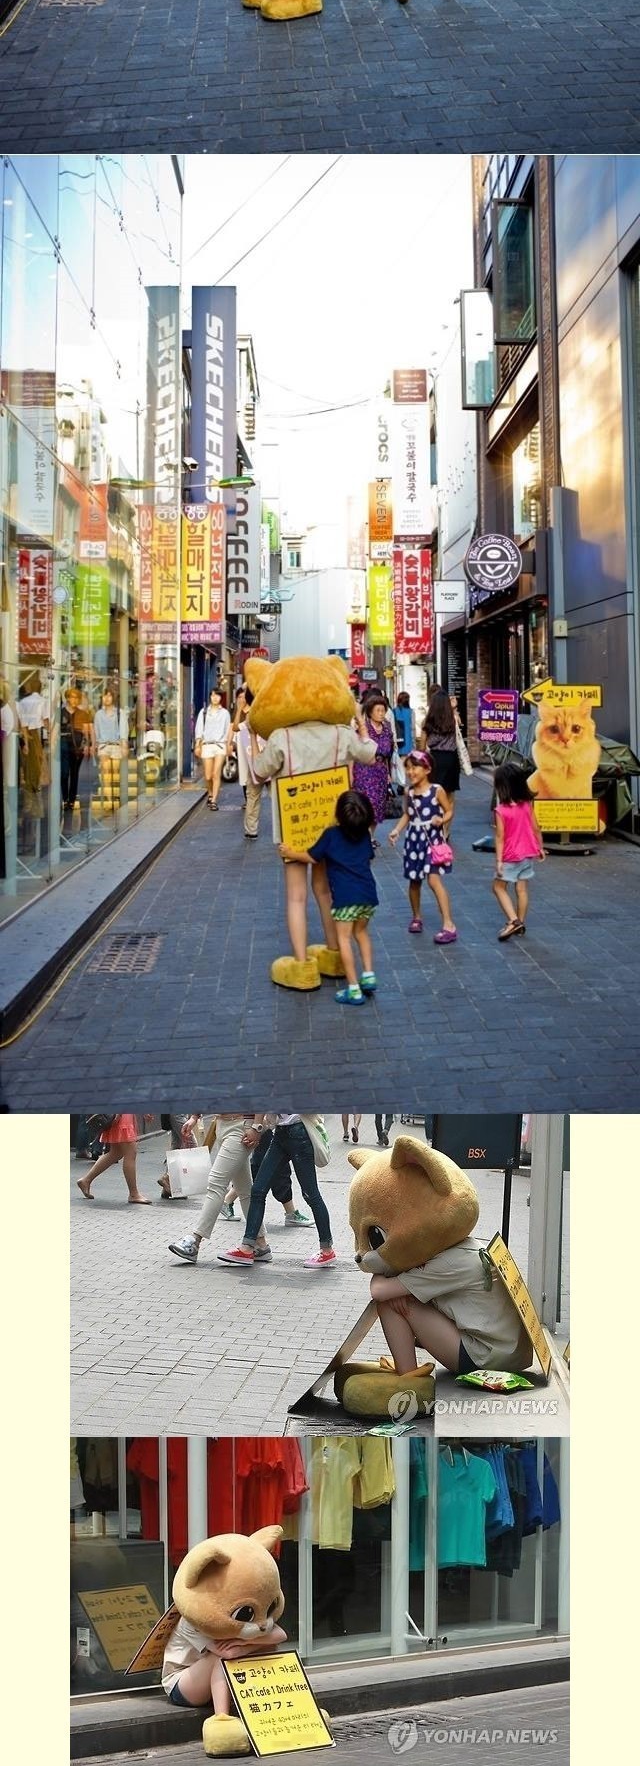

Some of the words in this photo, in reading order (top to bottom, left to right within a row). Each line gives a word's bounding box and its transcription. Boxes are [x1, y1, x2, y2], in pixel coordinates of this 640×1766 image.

[205, 312, 225, 504] SKECHERS
[376, 484, 387, 524] SEVEN
[226, 490, 249, 594] OFFEE
[185, 524, 208, 616] 할매낙지
[546, 690, 574, 703] 고양이
[467, 1148, 487, 1159] BSX
[248, 1666, 276, 1679] 고양이
[278, 1663, 301, 1674] 카페
[239, 1688, 255, 1699] CAT
[255, 1686, 270, 1697] cafe
[275, 1684, 295, 1694] Drink
[294, 1682, 309, 1692] free
